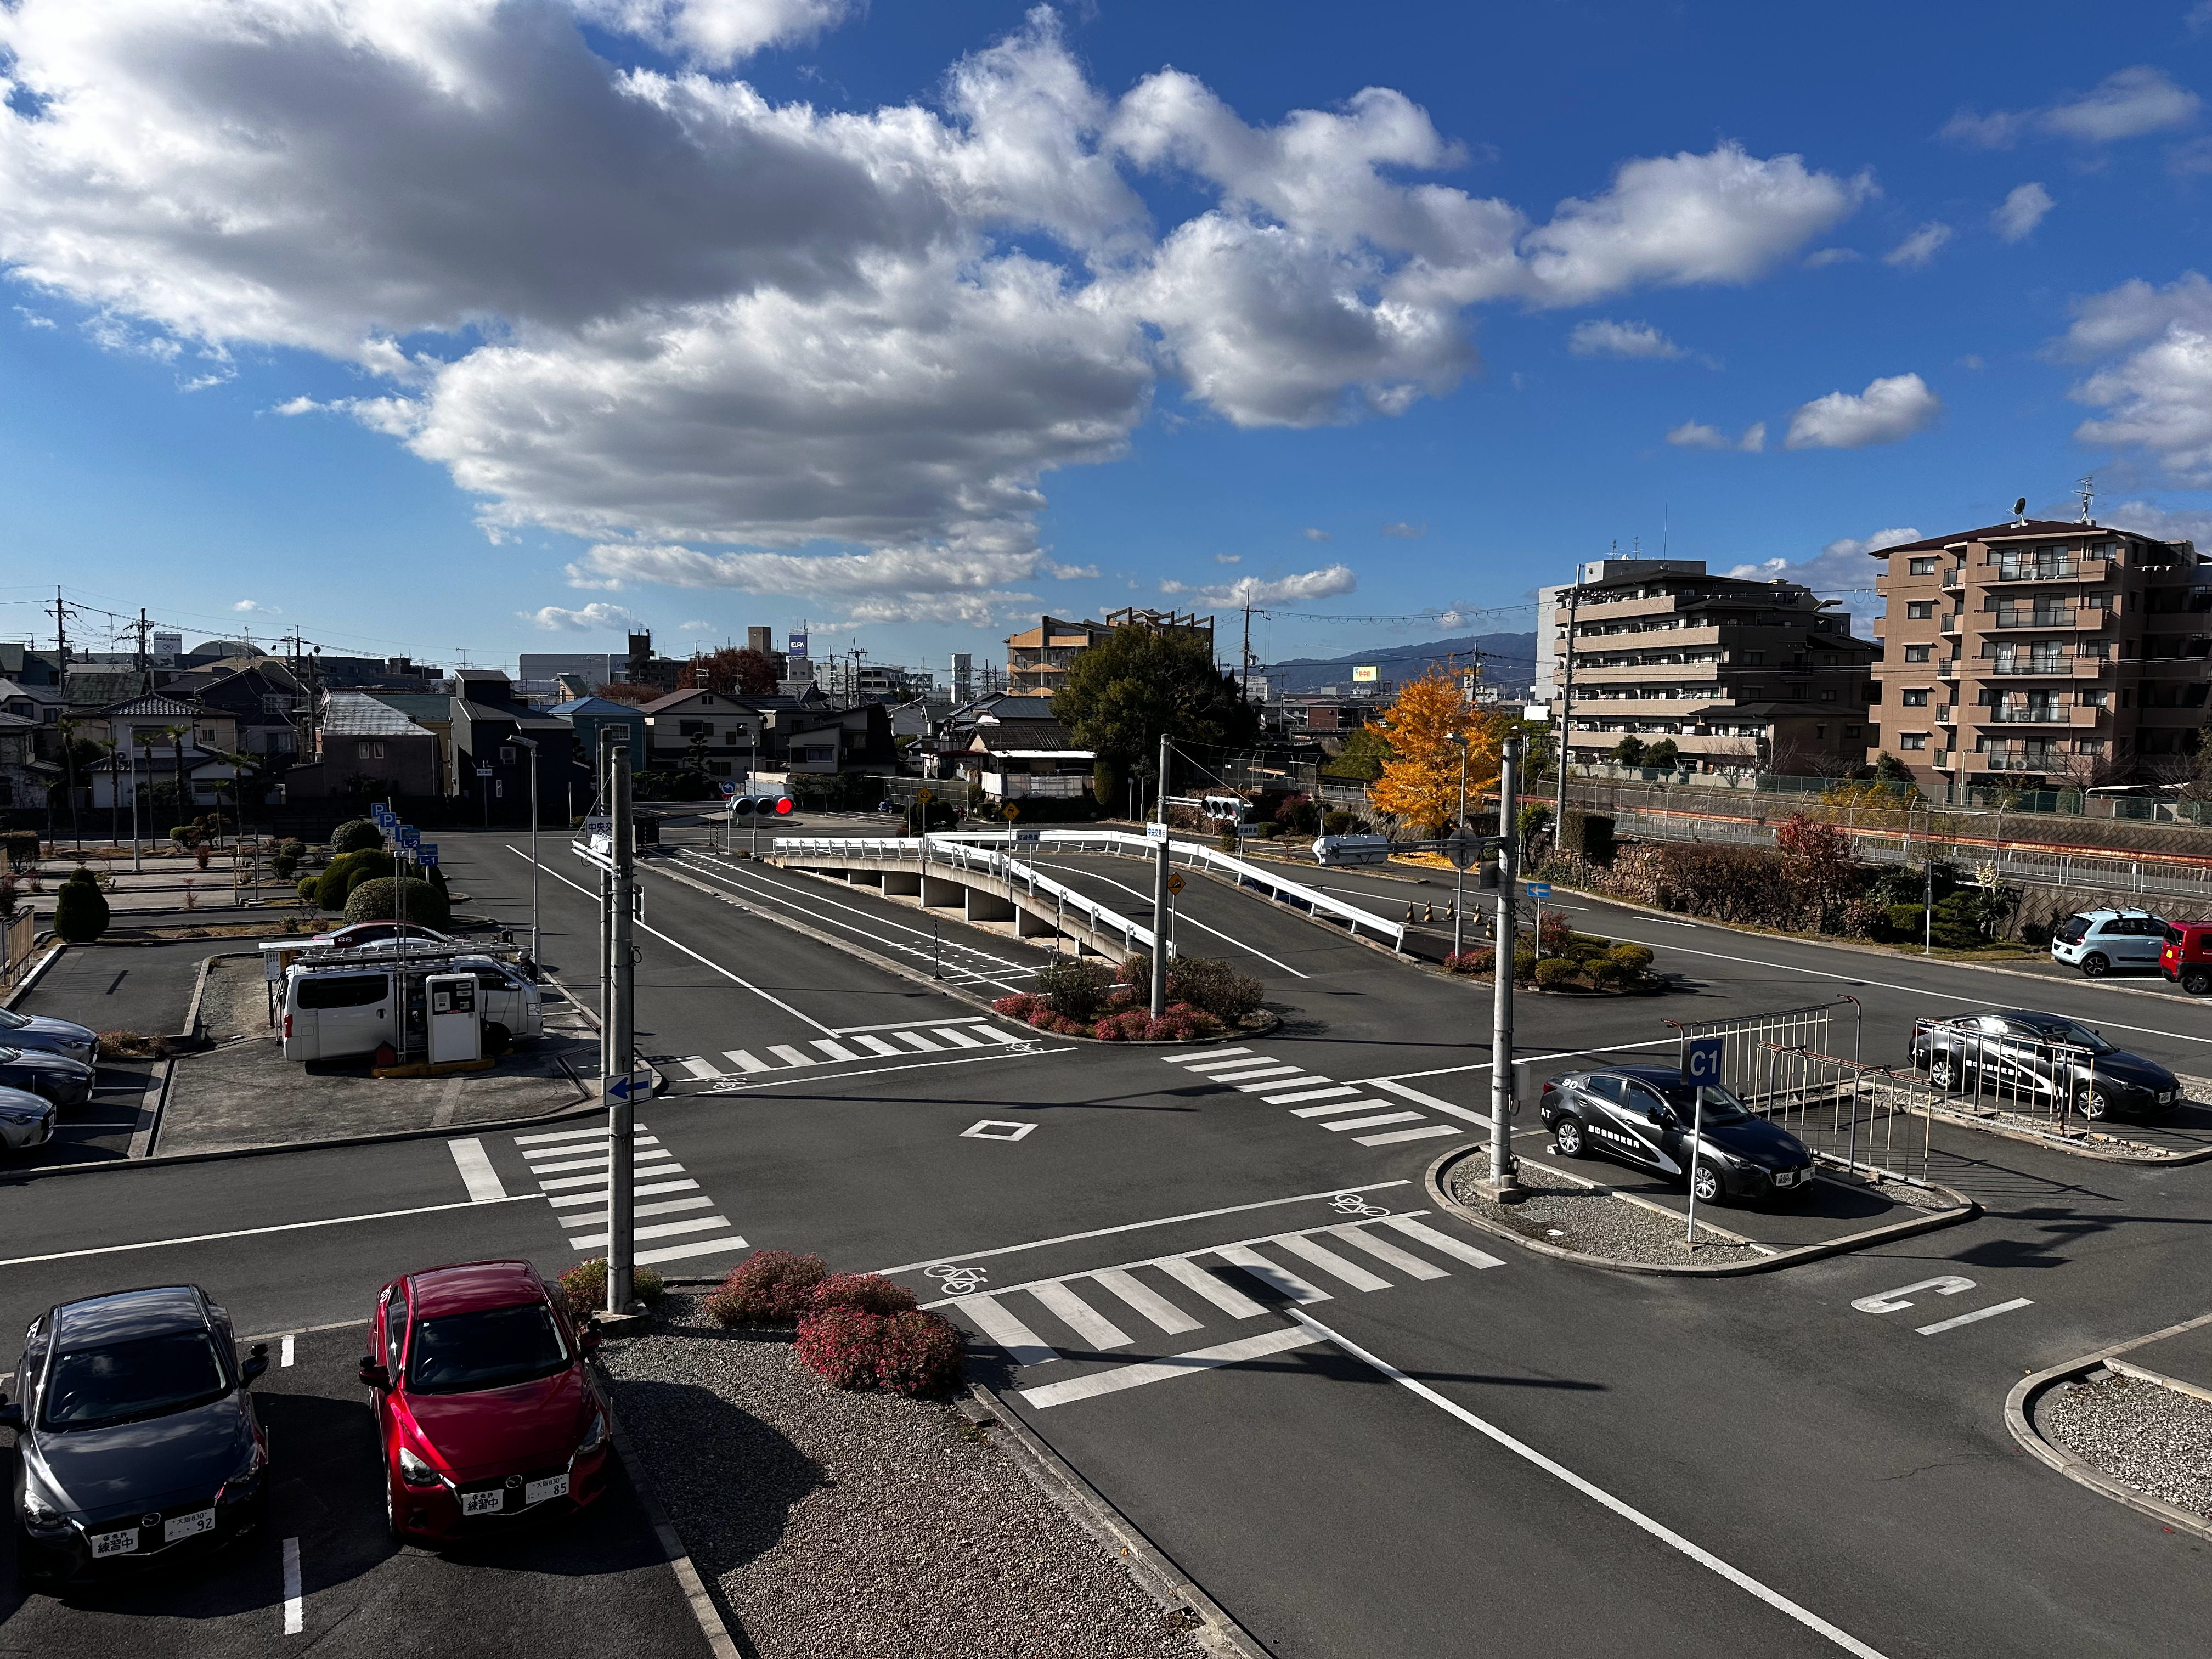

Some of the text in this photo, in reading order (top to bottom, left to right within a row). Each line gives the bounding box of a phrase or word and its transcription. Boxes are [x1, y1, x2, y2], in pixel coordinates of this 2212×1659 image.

[375, 805, 383, 816] P
[384, 814, 393, 826] P
[1690, 1050, 1717, 1076] C1
[1562, 1078, 1578, 1089] 90
[1541, 1108, 1551, 1119] AT
[554, 1482, 567, 1495] 85
[467, 1498, 499, 1511] 練習中
[198, 1517, 213, 1531] 92
[103, 1532, 127, 1541] 仮免許
[97, 1537, 133, 1554] 練習中
